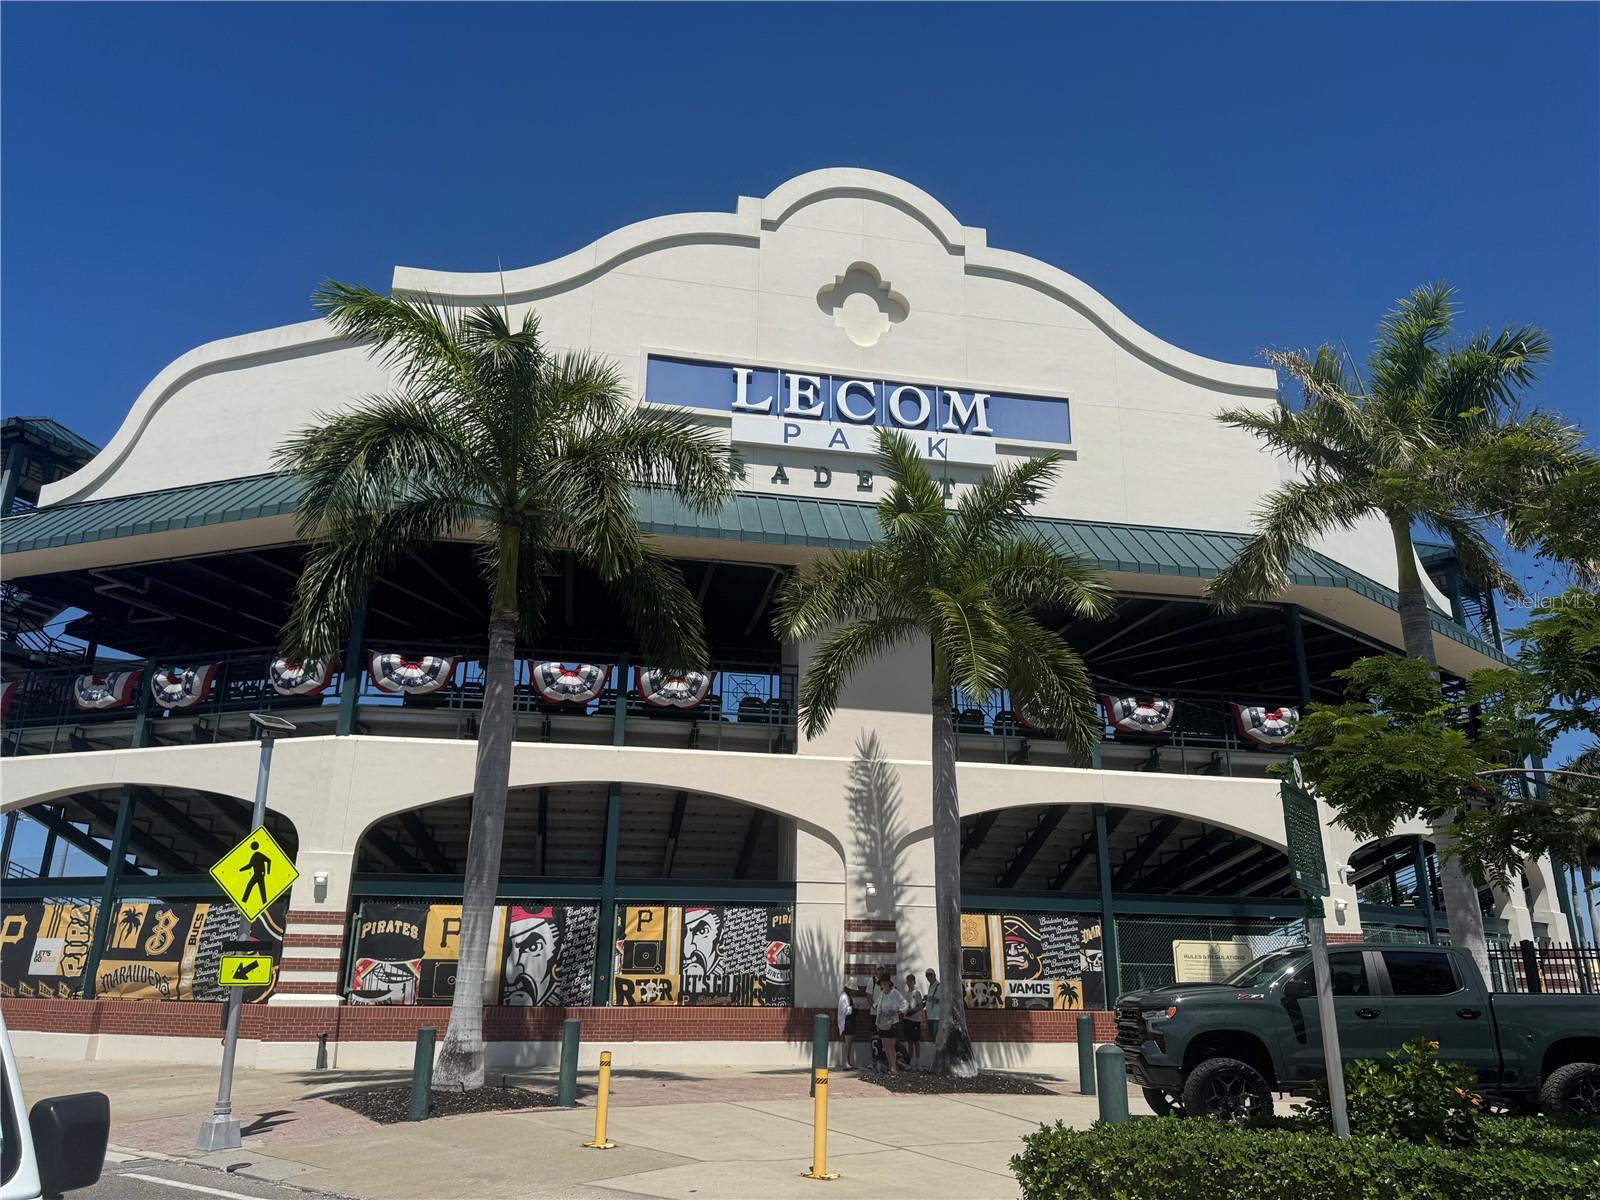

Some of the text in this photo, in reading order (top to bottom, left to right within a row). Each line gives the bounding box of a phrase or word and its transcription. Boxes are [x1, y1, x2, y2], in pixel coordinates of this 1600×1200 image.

[732, 368, 993, 435] LECOM
[783, 423, 947, 458] PAK
[188, 913, 205, 946] BUCS
[361, 920, 419, 939] PIRATES
[440, 917, 461, 948] P
[637, 910, 653, 932] P
[100, 964, 172, 997] MARAUDERS
[1008, 983, 1051, 995] VAMOS
